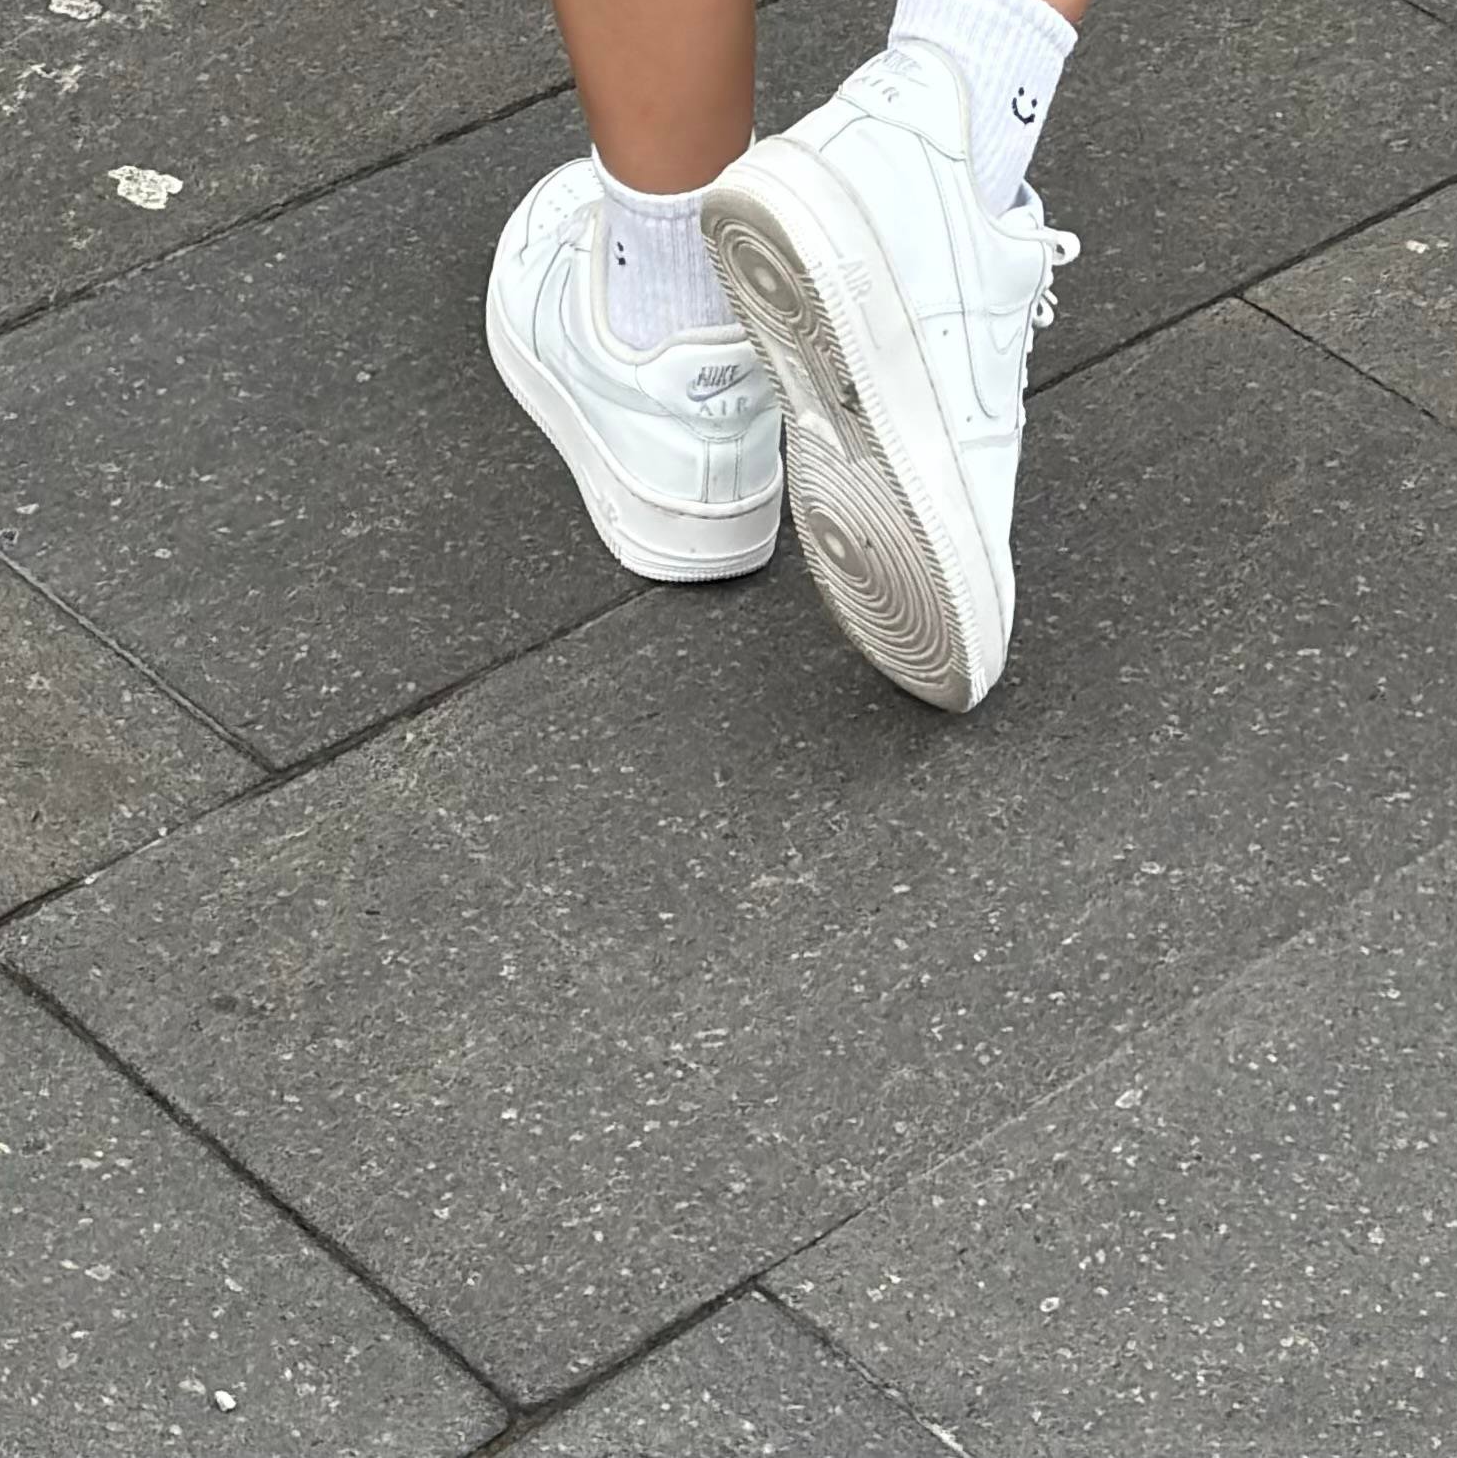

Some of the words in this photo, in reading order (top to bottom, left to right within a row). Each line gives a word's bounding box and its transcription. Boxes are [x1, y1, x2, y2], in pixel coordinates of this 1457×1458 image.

[837, 259, 873, 301] AIR
[696, 362, 741, 387] NIKE
[699, 395, 750, 418] AIR
